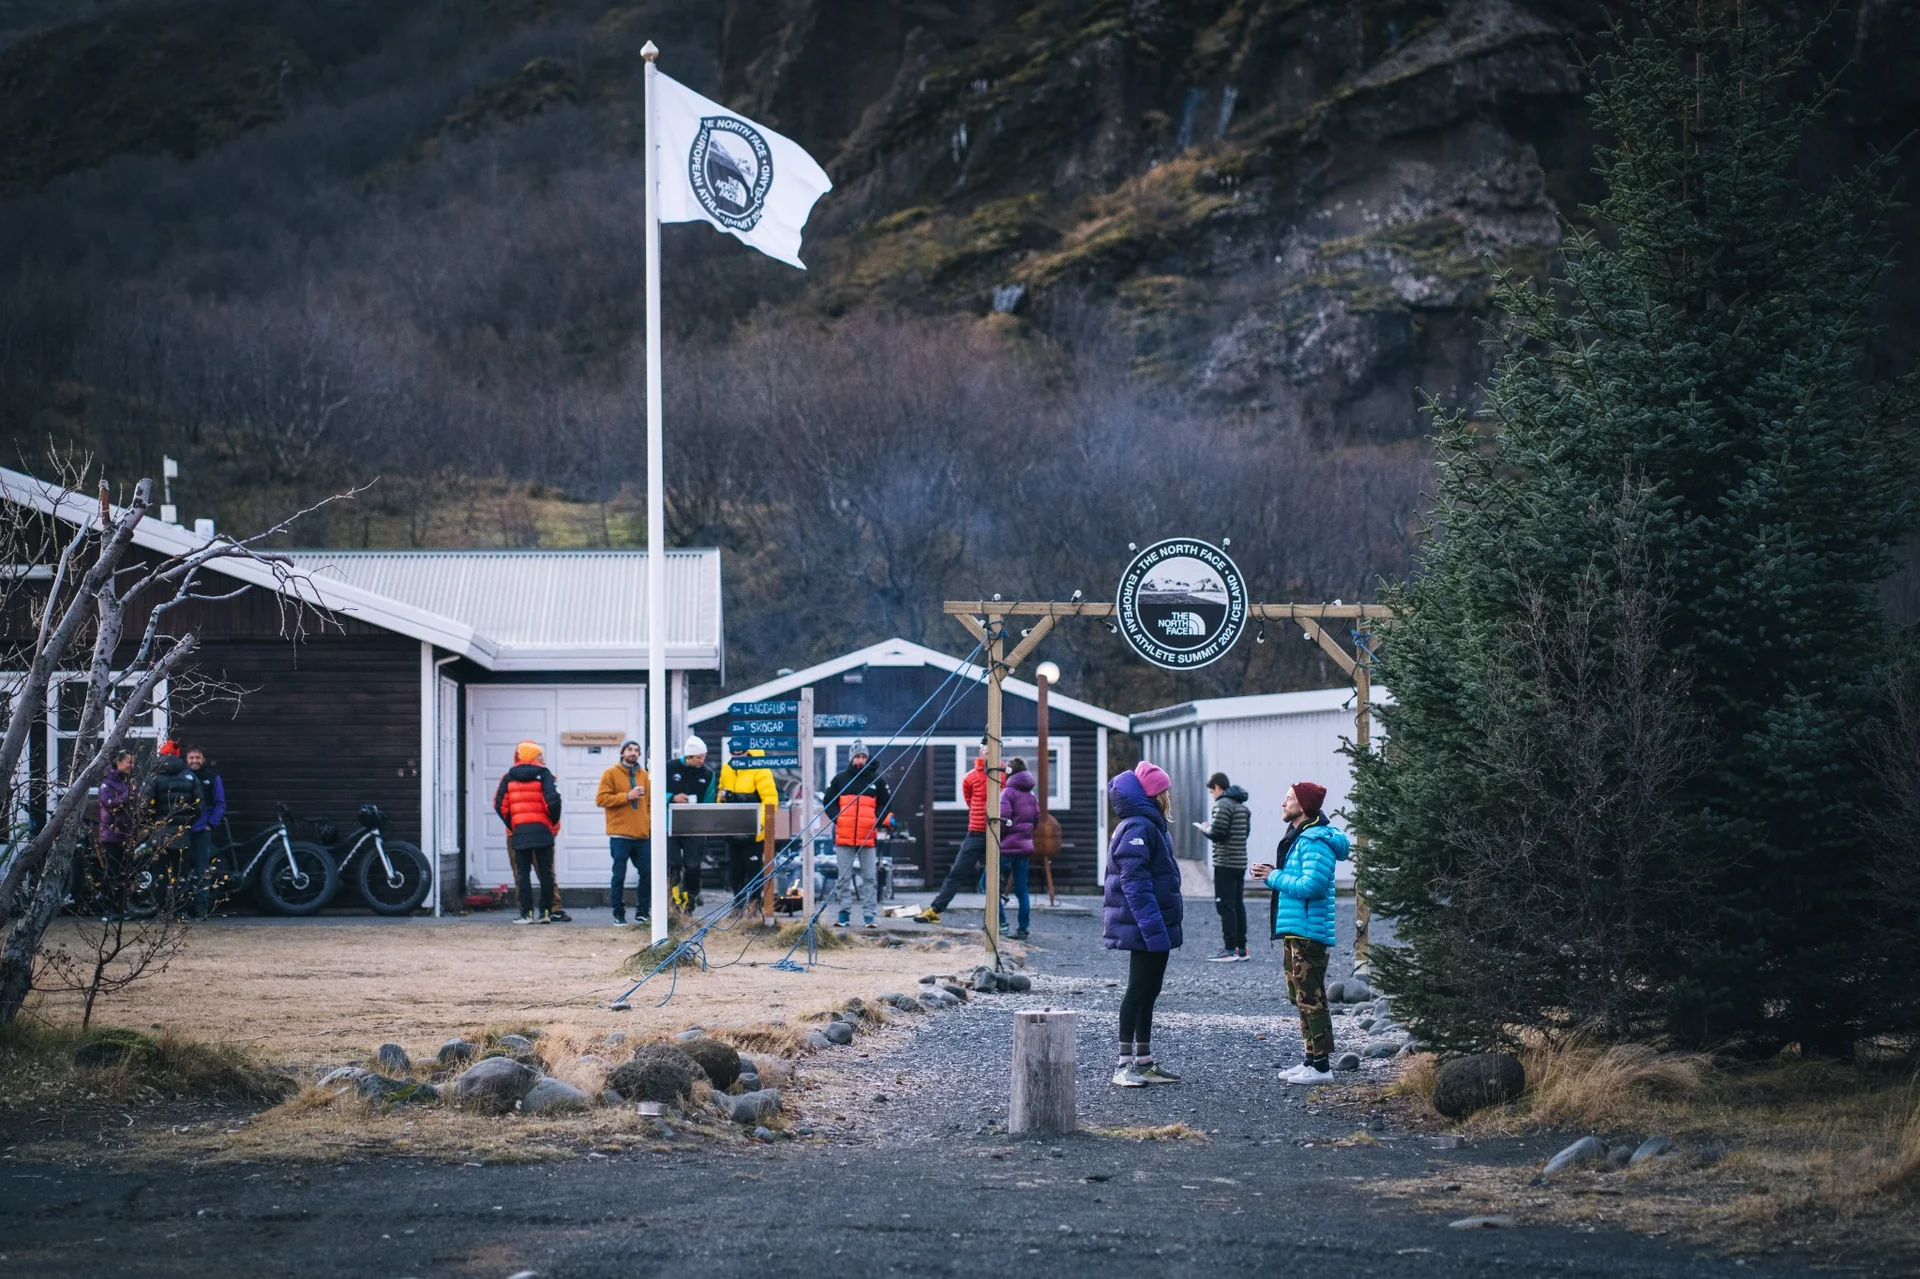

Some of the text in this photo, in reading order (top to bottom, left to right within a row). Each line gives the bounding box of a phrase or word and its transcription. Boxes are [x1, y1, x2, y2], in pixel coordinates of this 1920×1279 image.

[717, 119, 767, 158] NORTH FACE
[1137, 544, 1227, 571] THE NORTH FACE
[1122, 573, 1243, 664] EUROPEAN ATHLETE SUMMIT 2021 ICELAND
[1158, 619, 1189, 628] NORTH
[1171, 611, 1189, 620] THE
[1166, 627, 1189, 636] FACE
